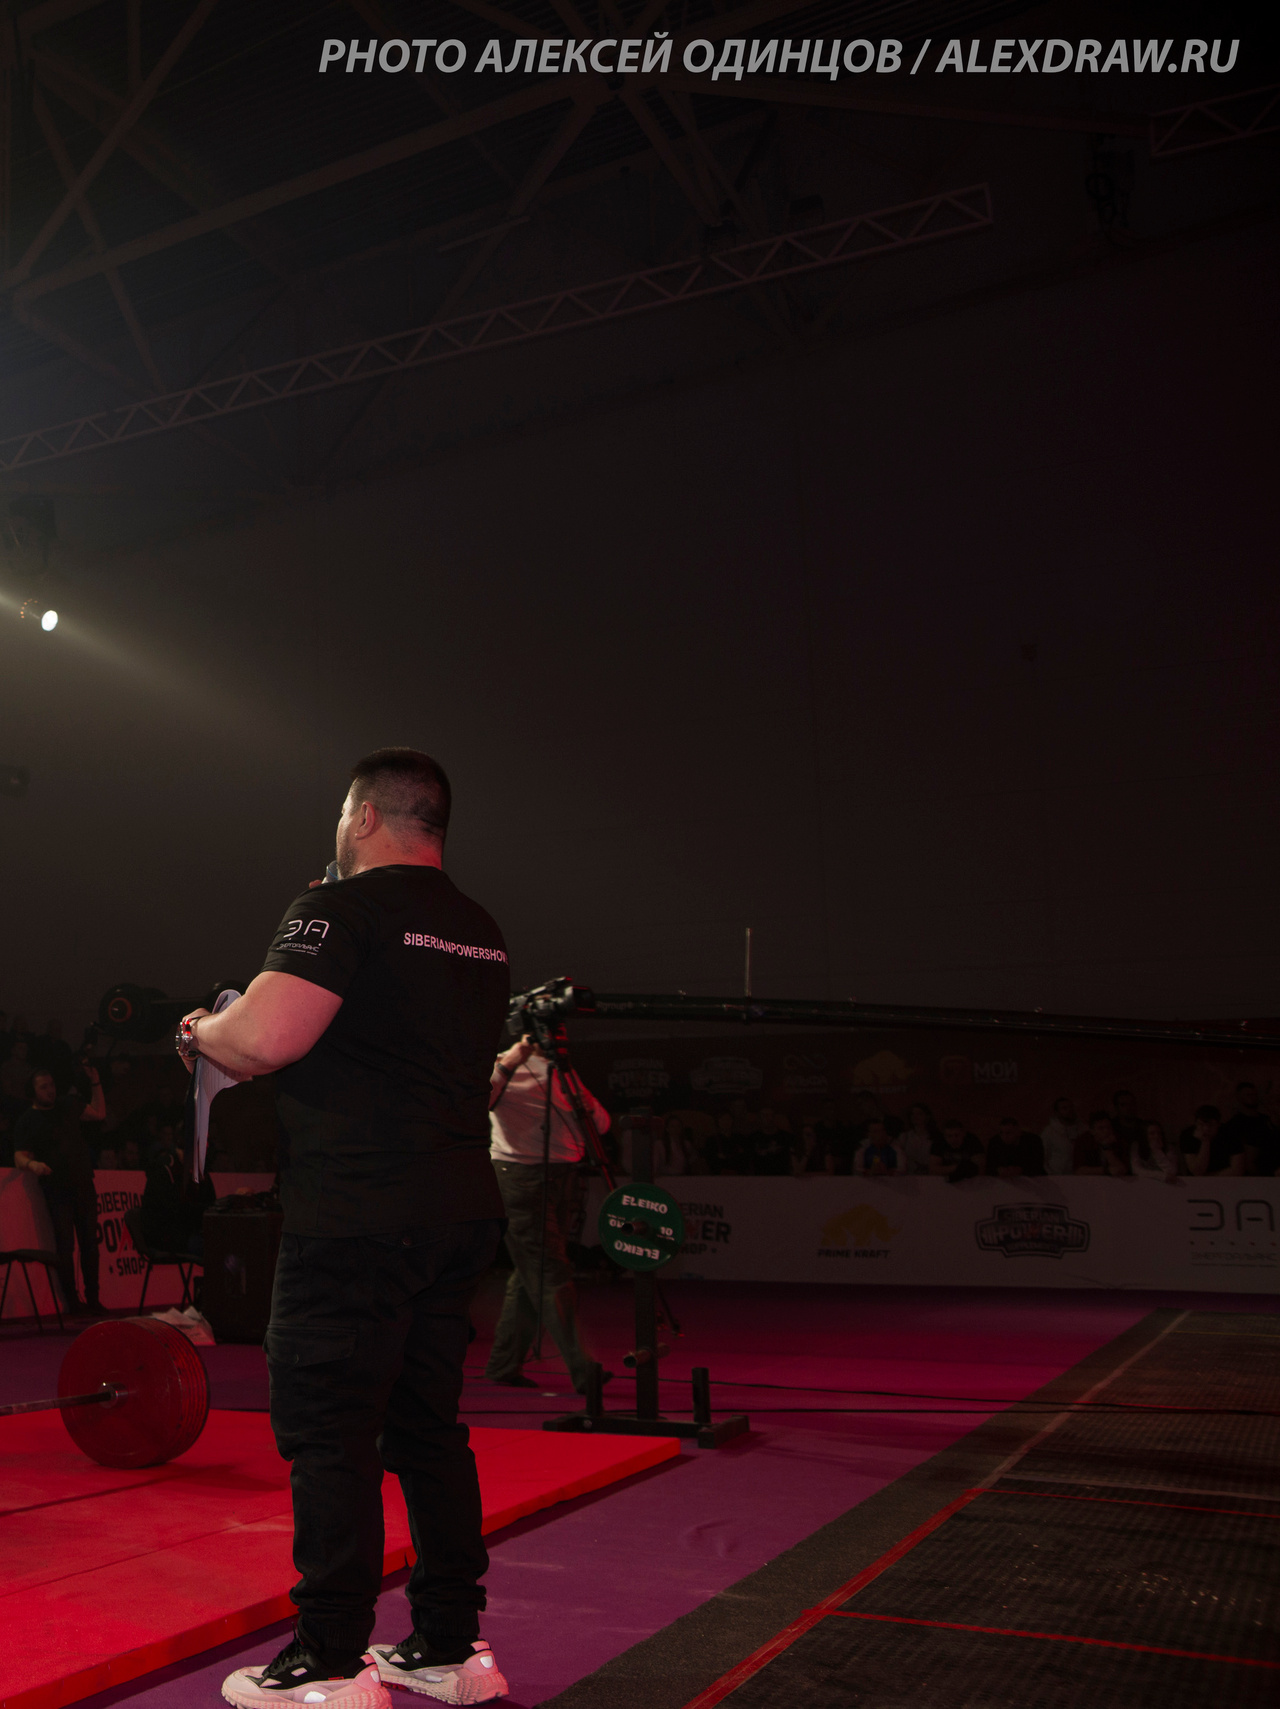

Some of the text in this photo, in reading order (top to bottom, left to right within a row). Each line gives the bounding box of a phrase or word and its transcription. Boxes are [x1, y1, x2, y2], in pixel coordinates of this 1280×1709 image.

[621, 1194, 669, 1216] ELEIKO
[681, 1202, 724, 1219] ERIAN
[660, 1225, 674, 1238] 10
[997, 1223, 1066, 1243] POWER
[613, 1239, 661, 1262] ELEIKO
[681, 1242, 708, 1255] HOP
[817, 1248, 891, 1259] PRIME KRAFT
[116, 1256, 145, 1276] SHOP
